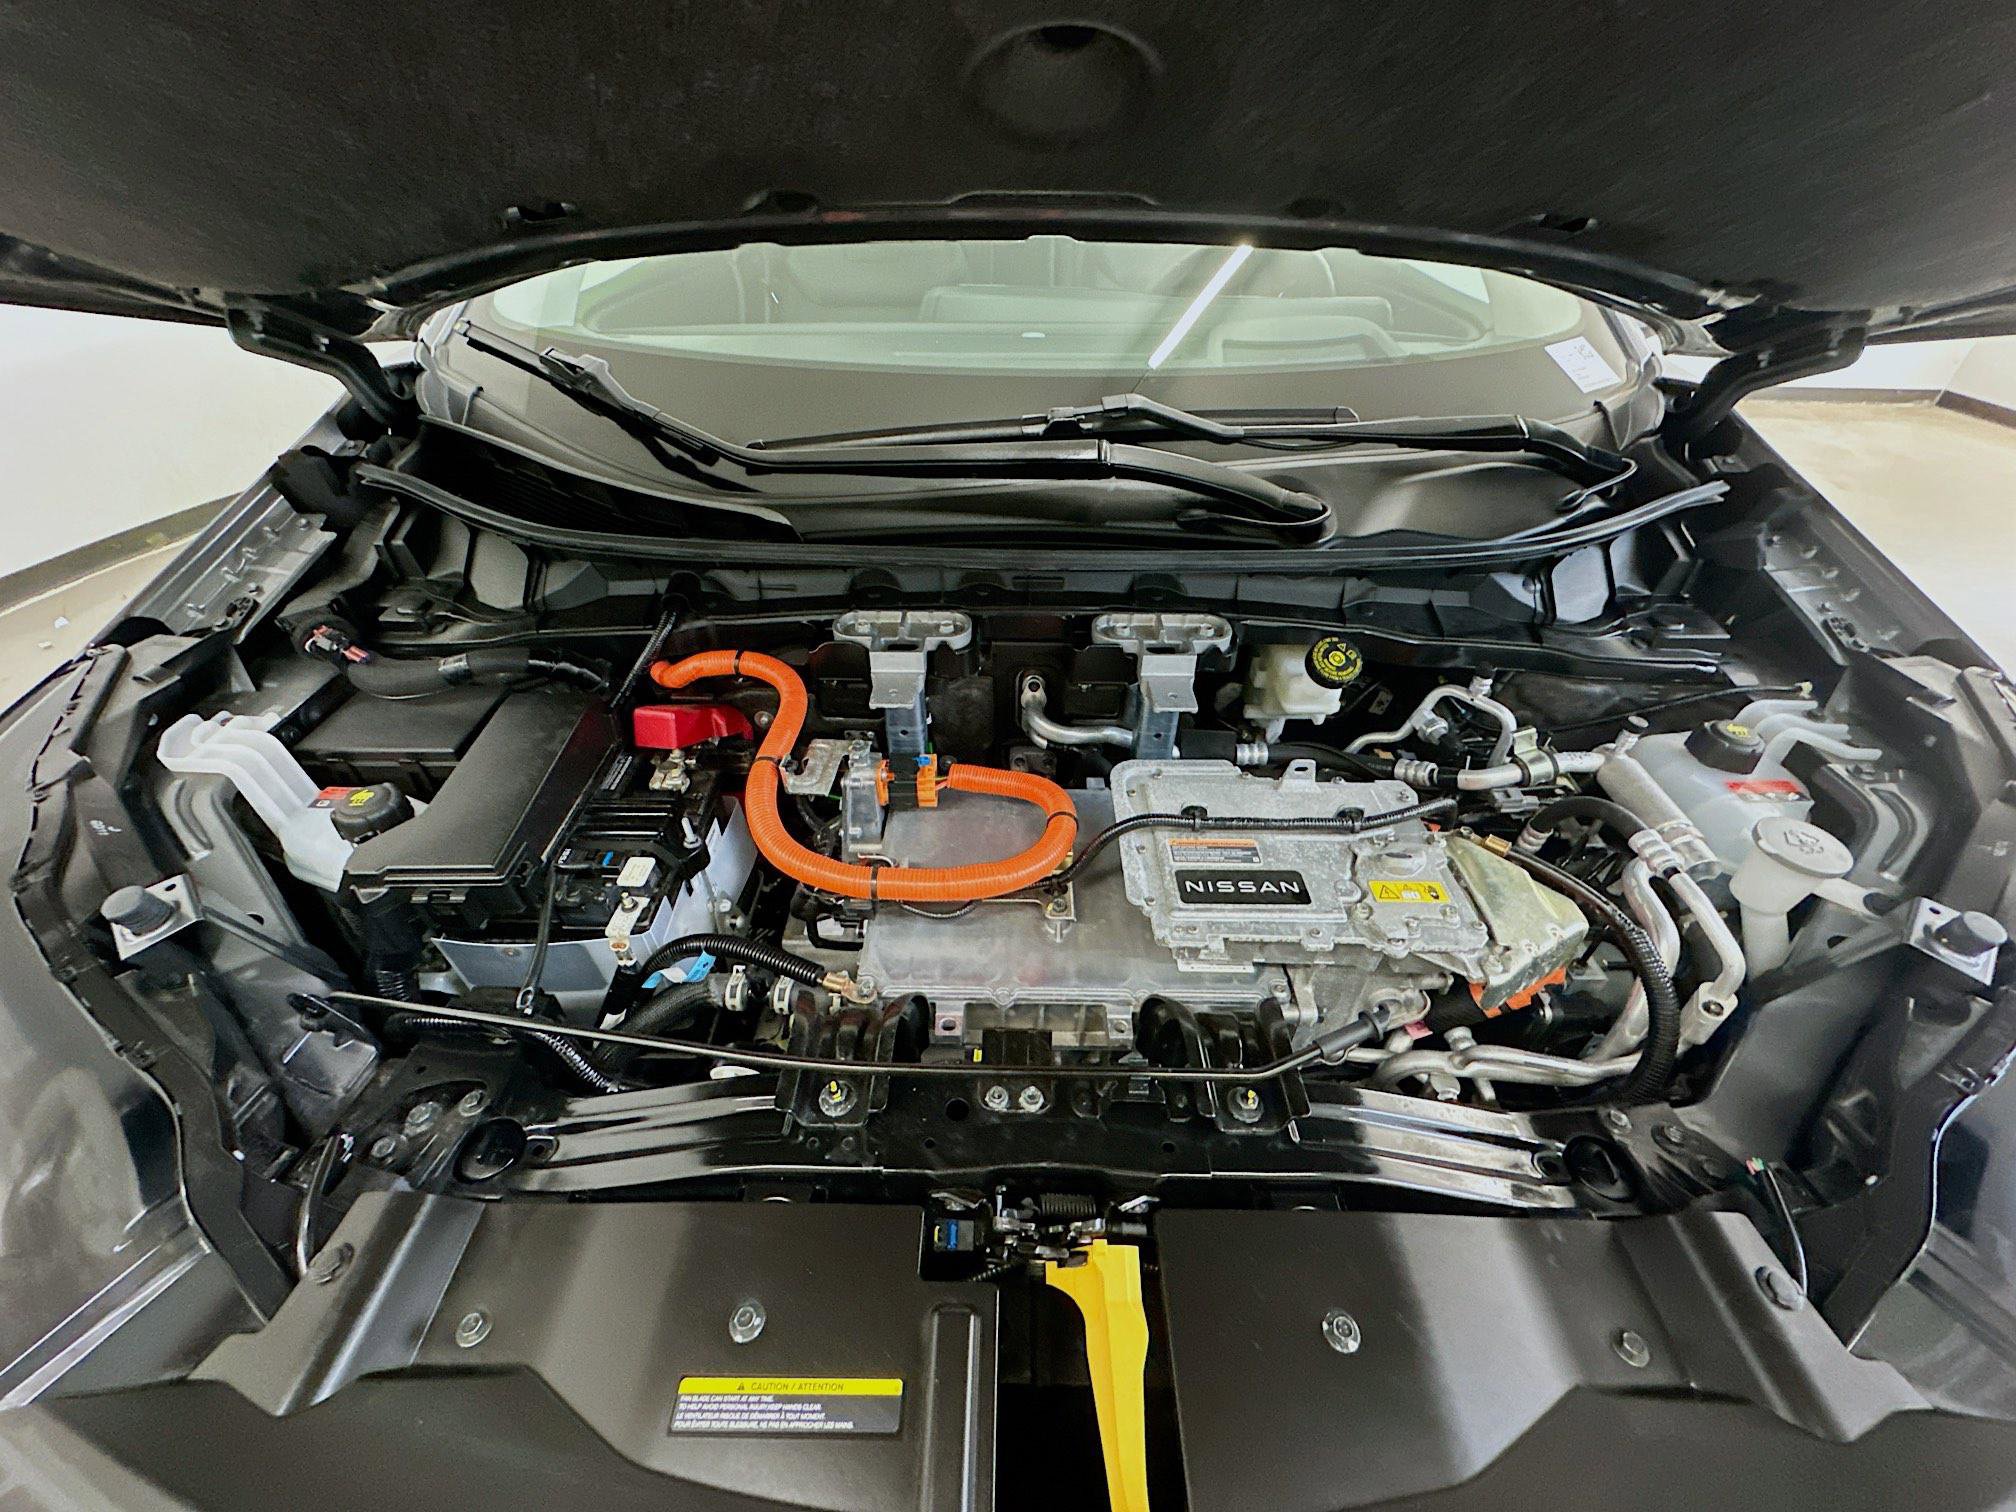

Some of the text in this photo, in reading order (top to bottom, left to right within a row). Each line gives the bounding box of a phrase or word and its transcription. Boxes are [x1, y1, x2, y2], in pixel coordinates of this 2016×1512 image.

[1185, 881, 1299, 893] NISSAN
[751, 1382, 845, 1391] CAUTION / ATTENTION
